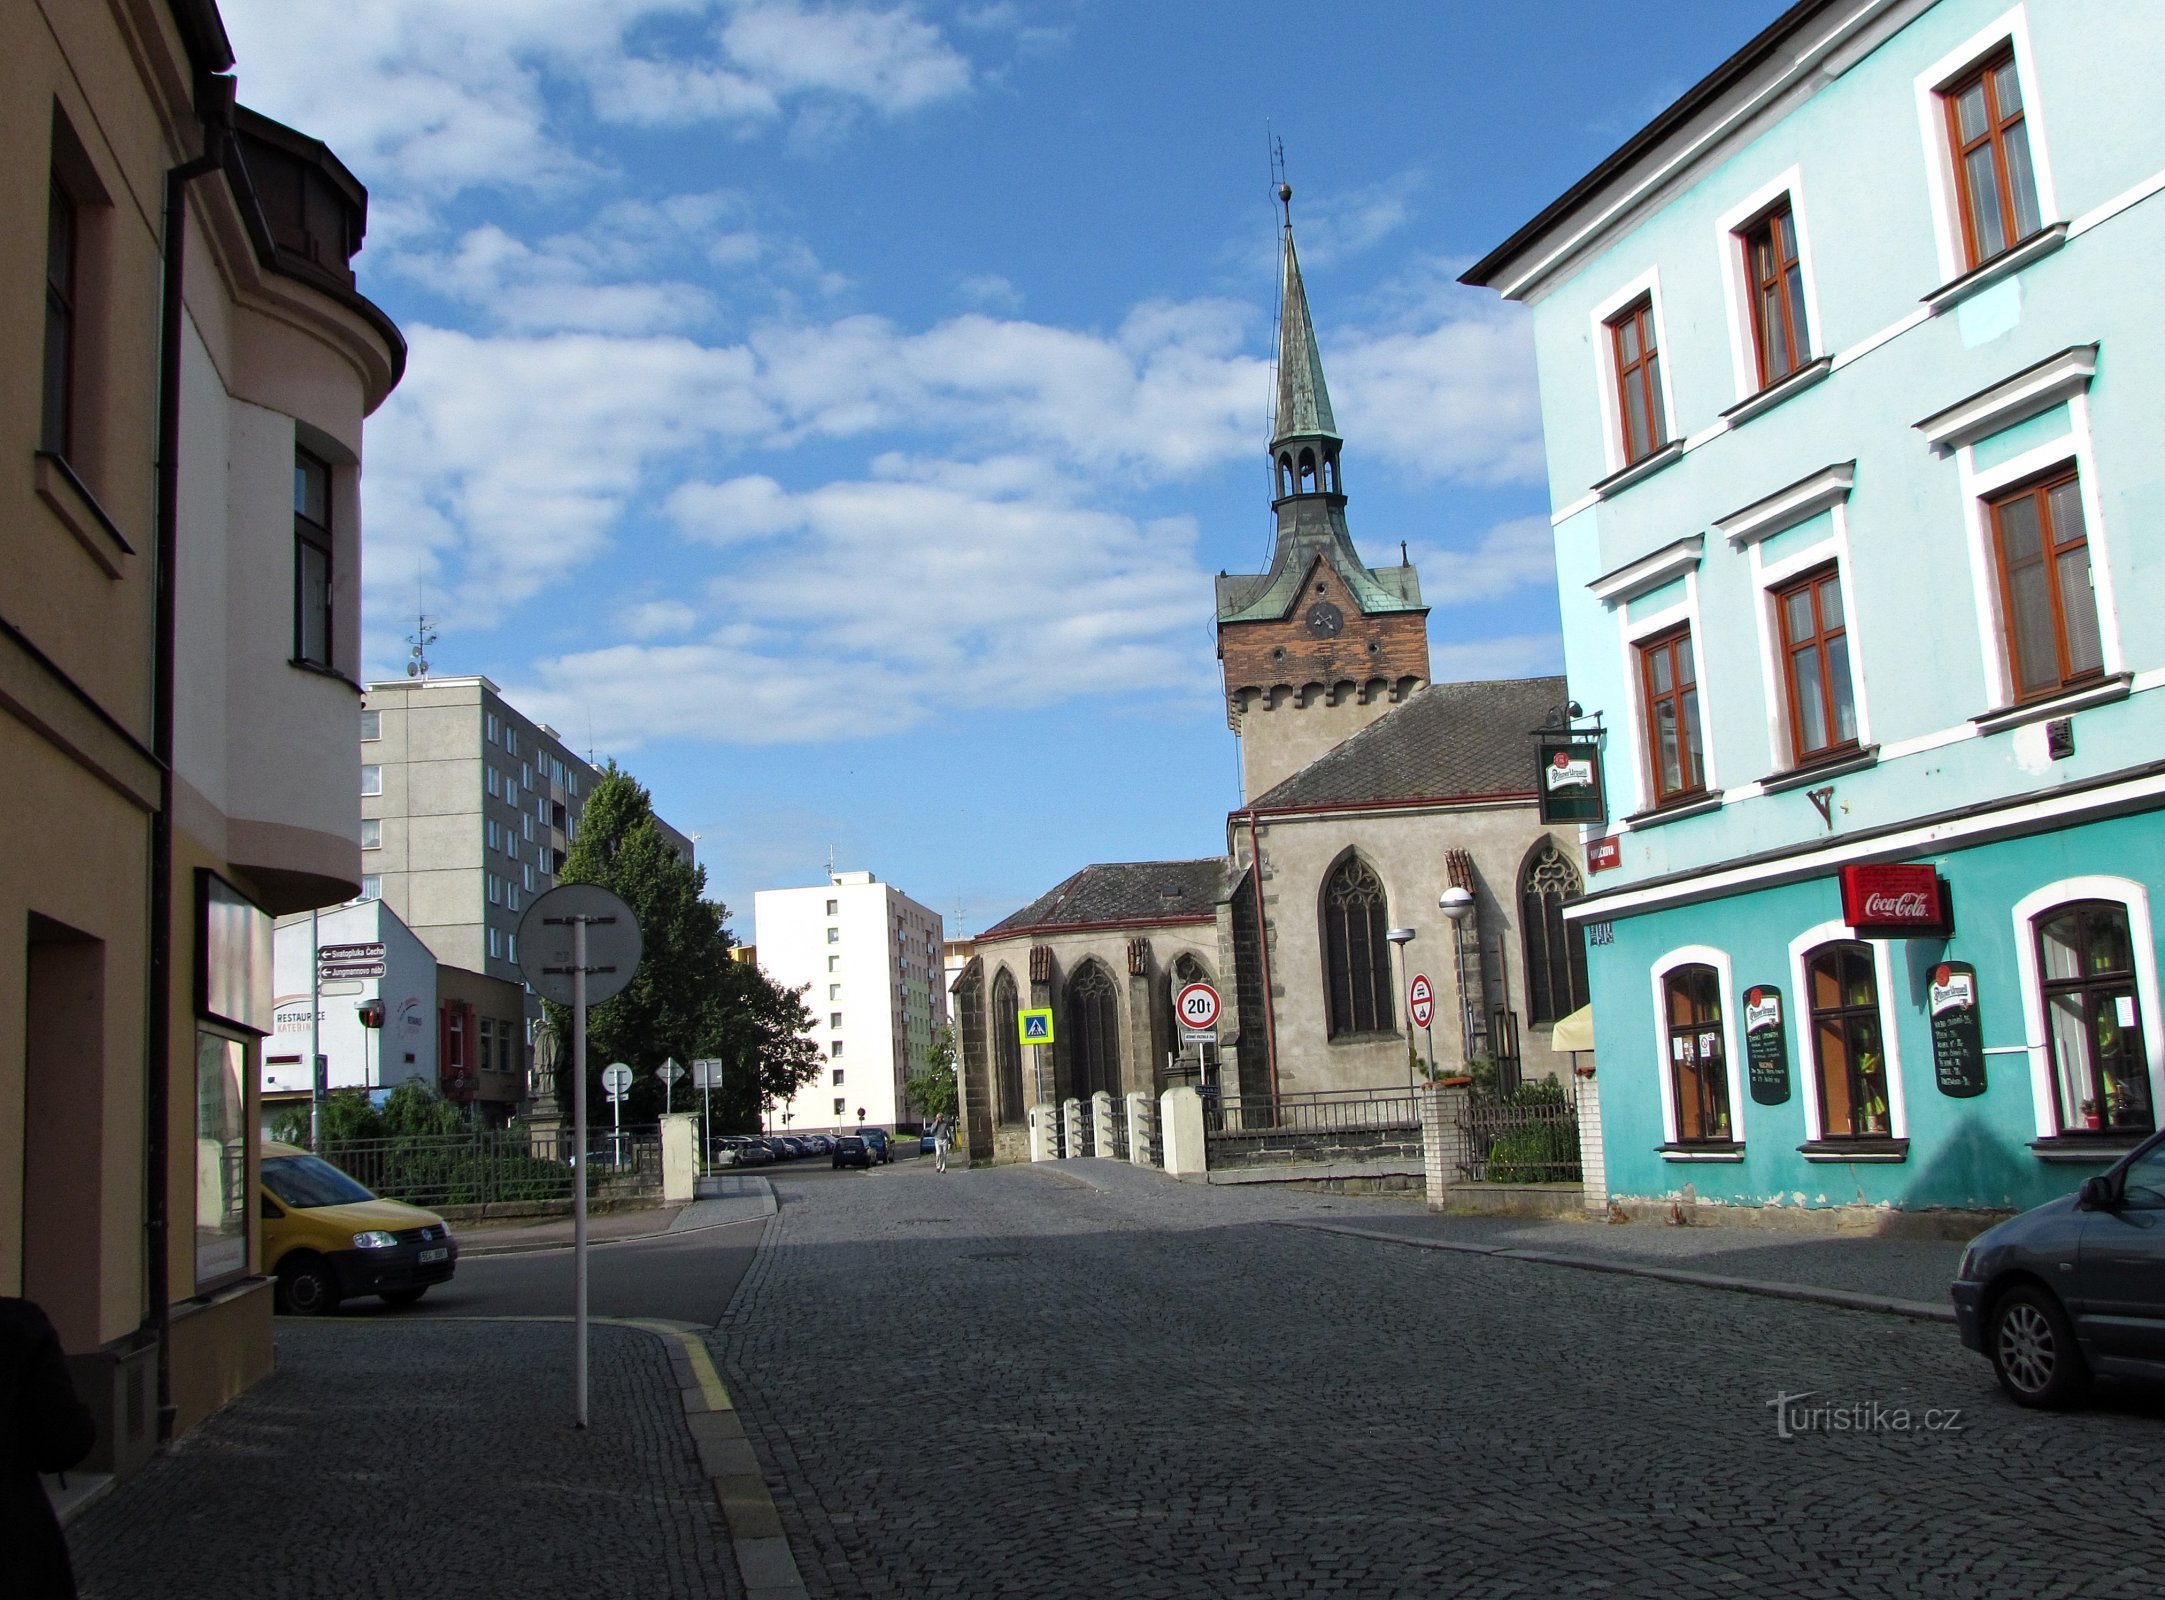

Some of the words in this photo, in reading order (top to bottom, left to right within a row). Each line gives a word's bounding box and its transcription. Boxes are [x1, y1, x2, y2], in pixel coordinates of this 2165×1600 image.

[1865, 892, 1928, 917] Coca-Cola
[332, 948, 364, 958] Svatopluka
[366, 946, 384, 956] Čecha
[332, 967, 369, 977] Jungmannovo
[277, 1011, 326, 1023] RESTAURCE
[277, 1022, 313, 1033] KATERIN
